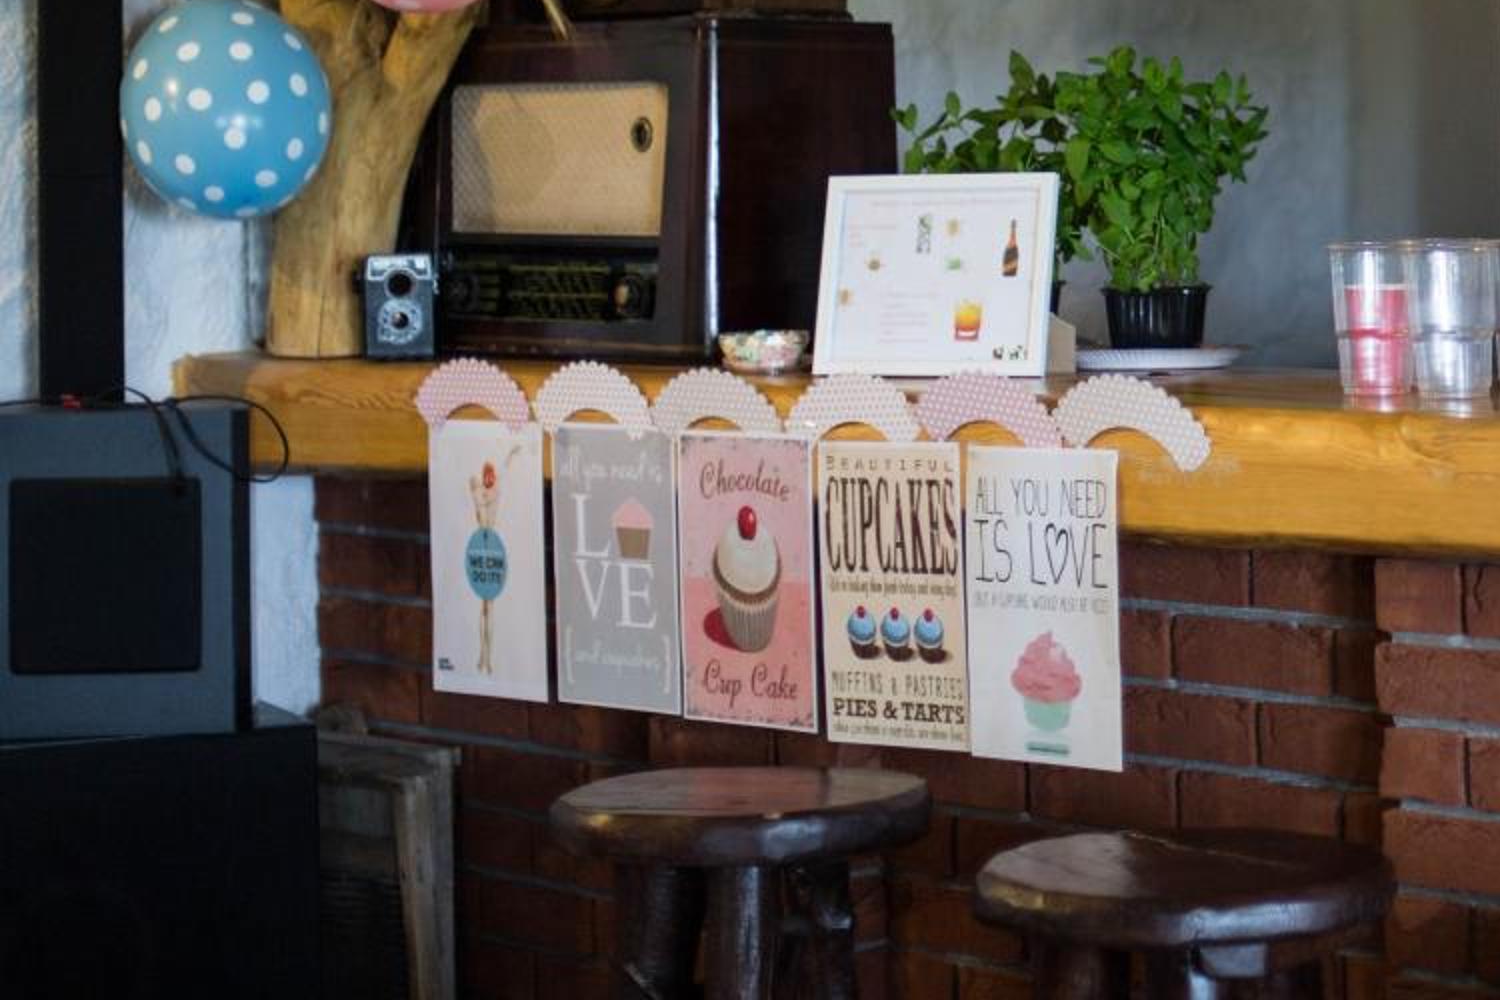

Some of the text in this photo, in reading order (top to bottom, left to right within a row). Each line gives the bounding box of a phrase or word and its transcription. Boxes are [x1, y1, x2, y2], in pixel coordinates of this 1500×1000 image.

[700, 458, 790, 501] Chocolate
[826, 455, 954, 472] BEAUTIFUL
[975, 477, 1108, 519] ALL YOU NEED
[825, 475, 958, 577] CUPCAKES
[974, 519, 1013, 583] IS
[703, 659, 799, 708] Cup Cake
[905, 674, 963, 701] PASTRIES
[833, 698, 965, 724] PIES & TARTS
